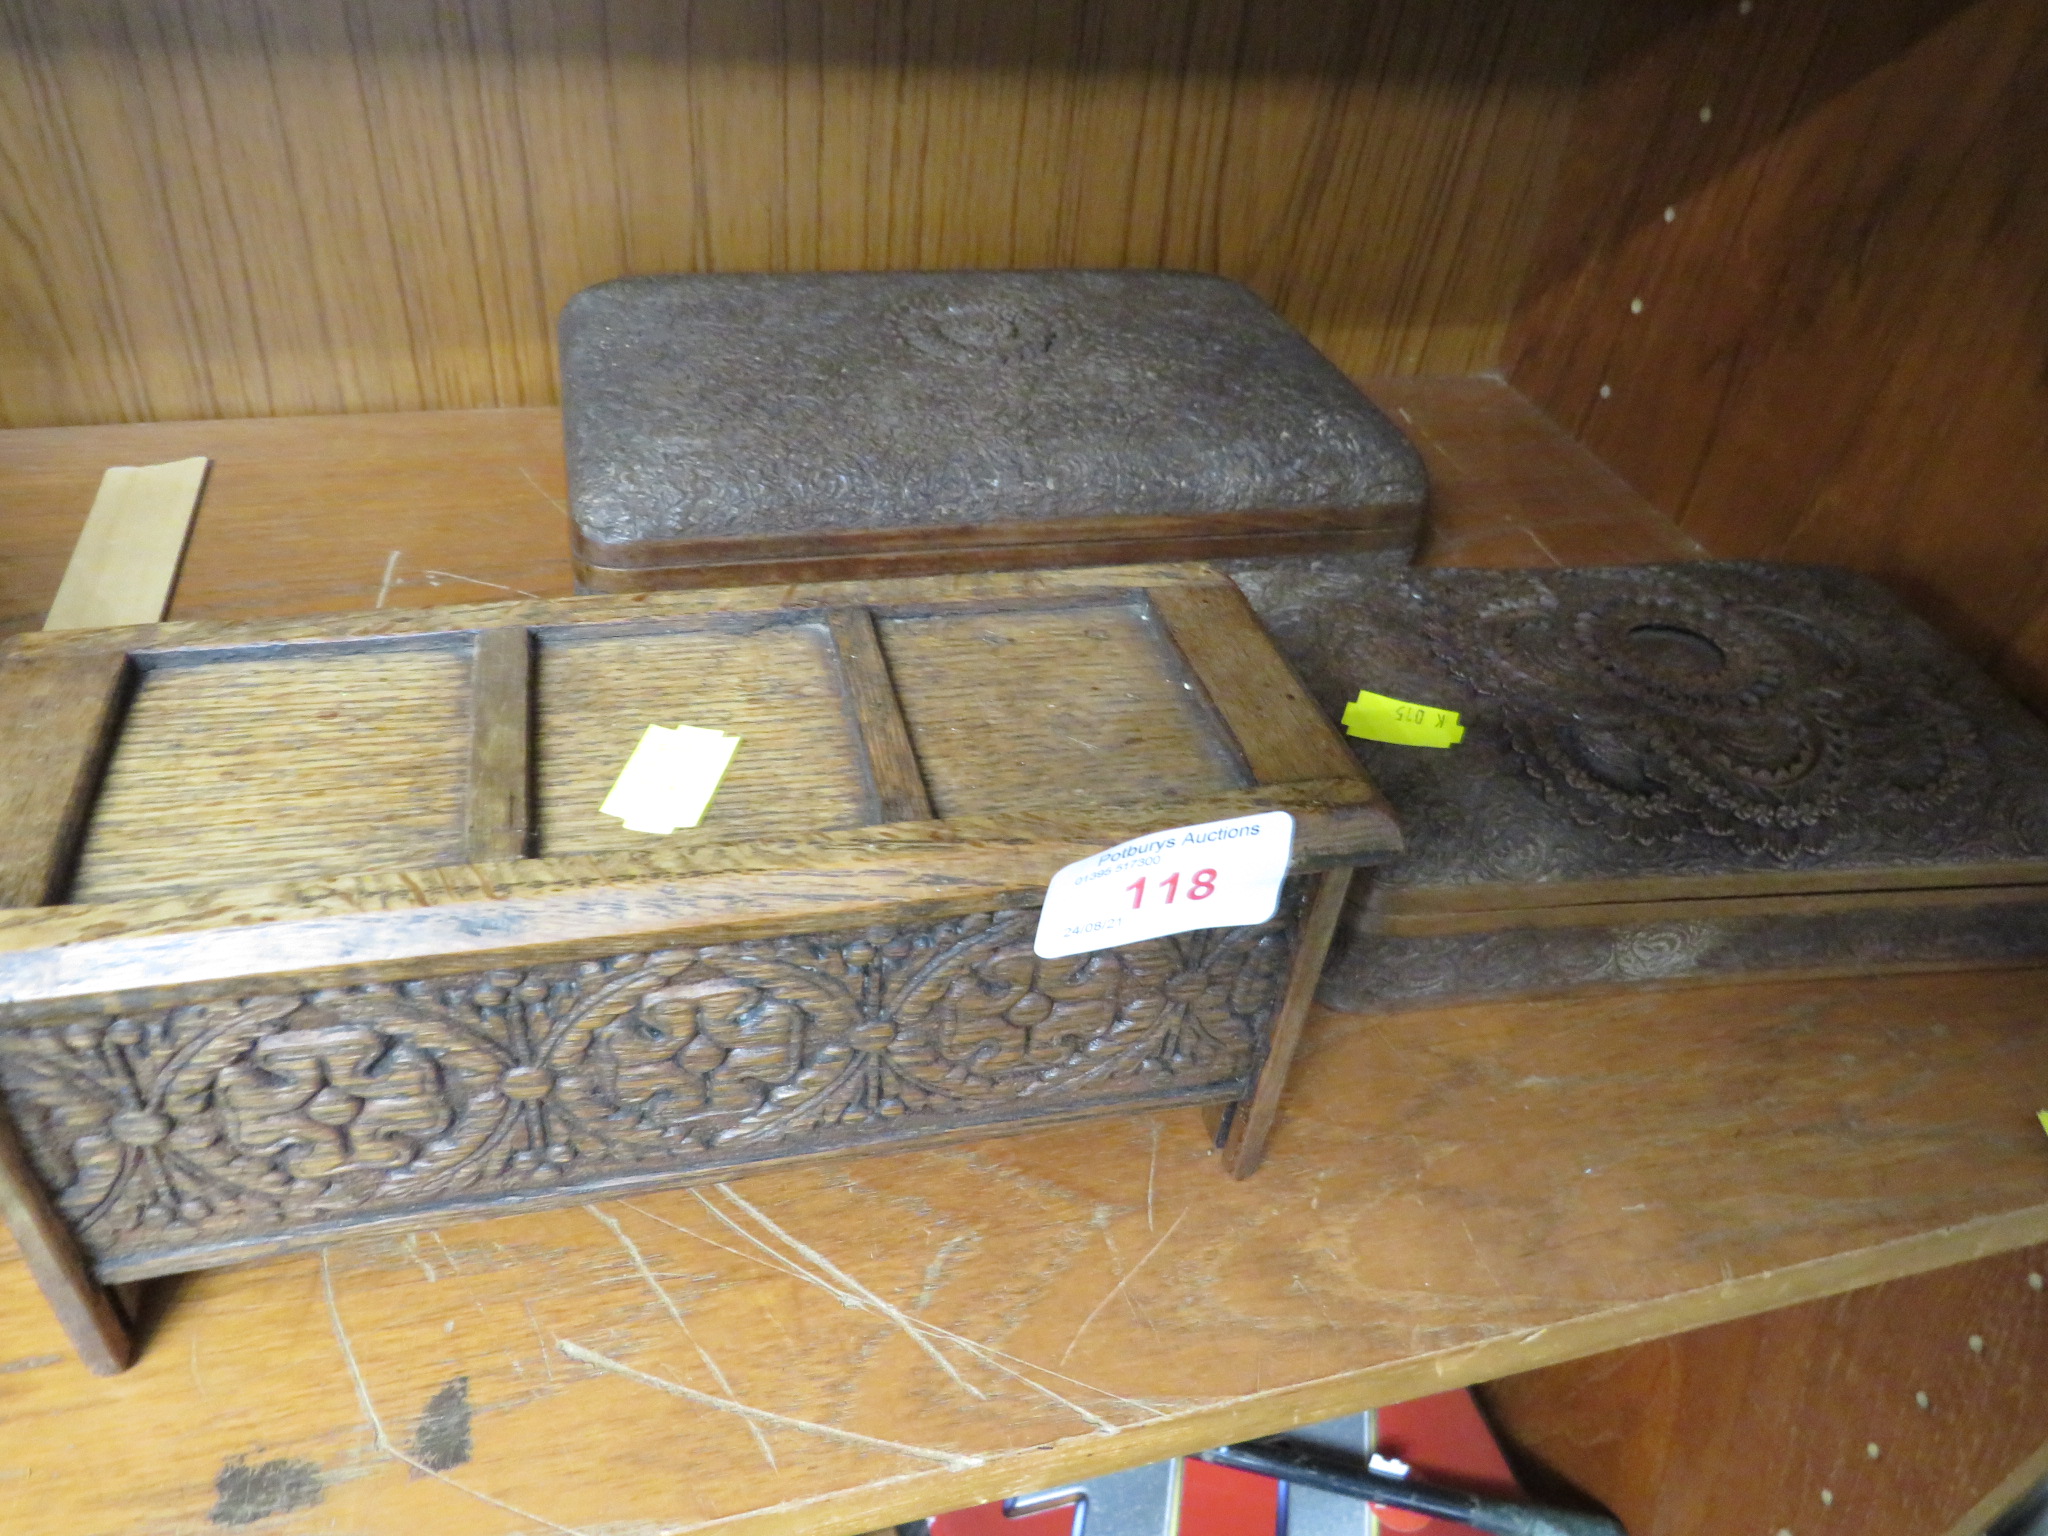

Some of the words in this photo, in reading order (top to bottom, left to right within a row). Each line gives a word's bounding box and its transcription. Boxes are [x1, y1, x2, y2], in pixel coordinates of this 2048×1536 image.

[1435, 713, 1446, 729] K
[1097, 835, 1177, 867] Potburys
[1181, 822, 1261, 847] Auctions
[1125, 867, 1219, 910] 118
